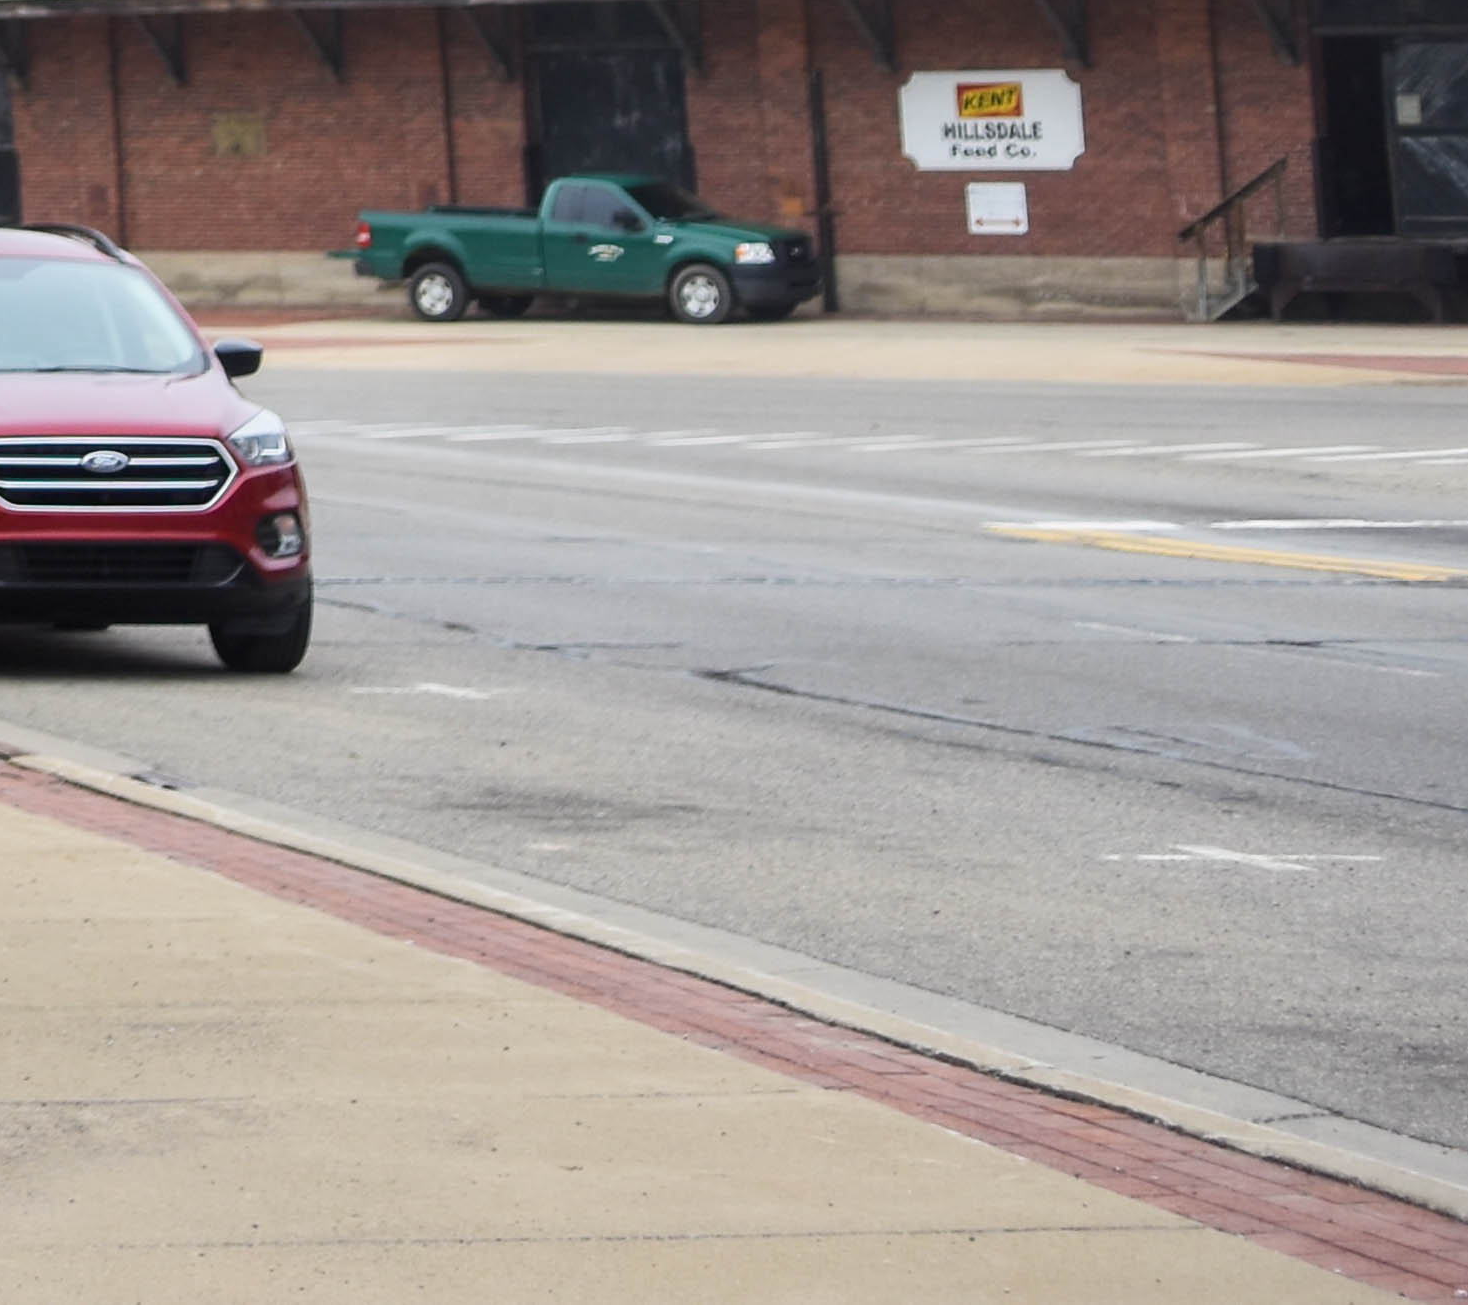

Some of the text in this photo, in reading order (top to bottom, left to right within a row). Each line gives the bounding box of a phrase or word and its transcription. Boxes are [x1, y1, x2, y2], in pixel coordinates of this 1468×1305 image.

[962, 87, 1018, 111] KENT
[943, 121, 1042, 140] HILLSDALE
[1006, 144, 1037, 157] Co.
